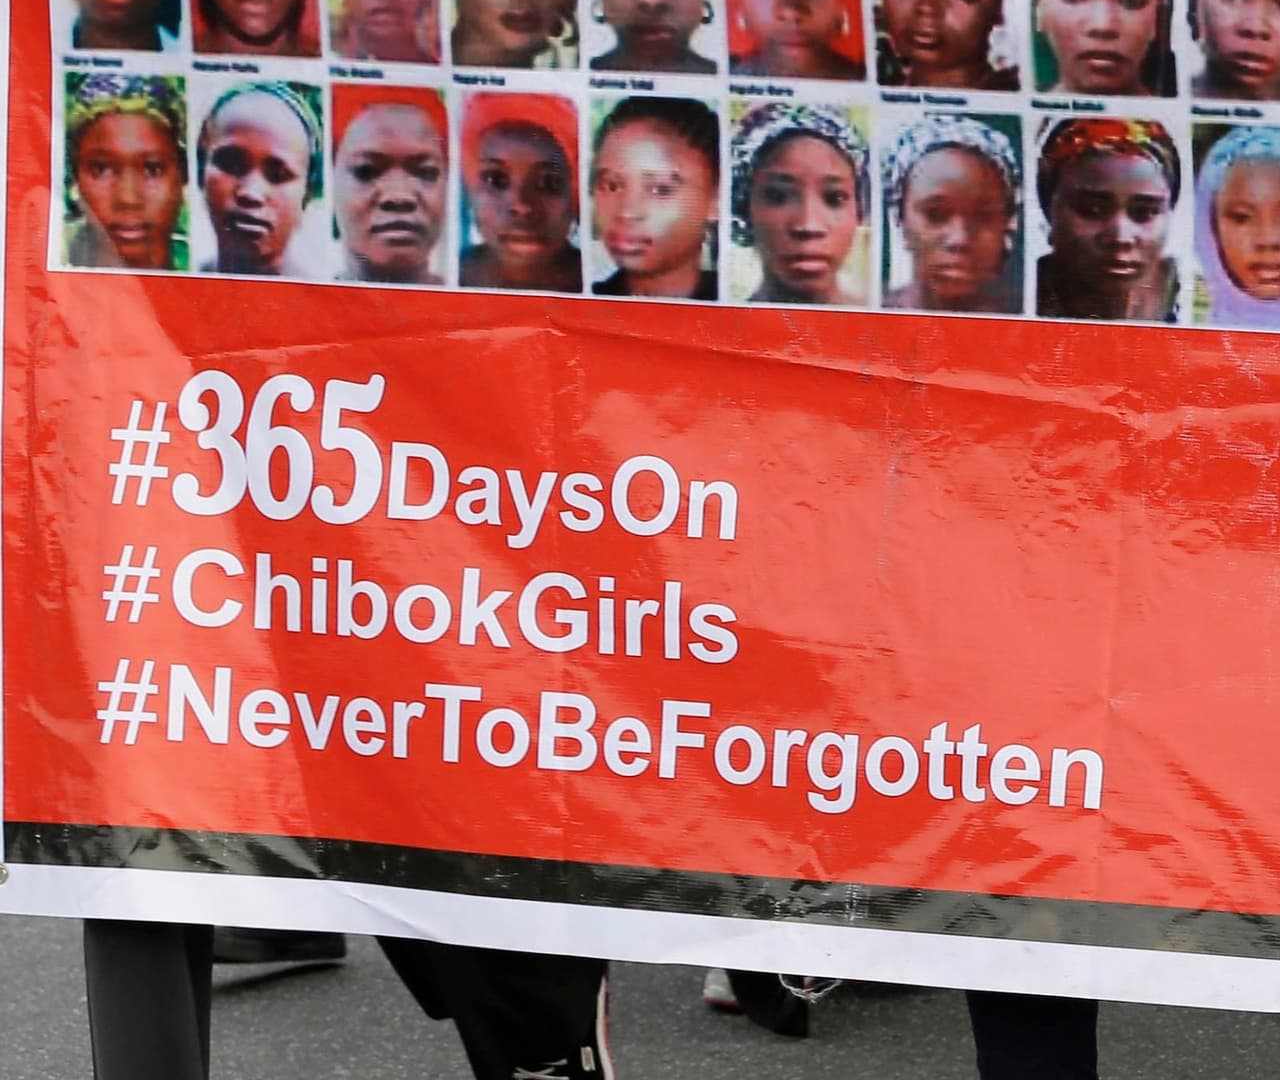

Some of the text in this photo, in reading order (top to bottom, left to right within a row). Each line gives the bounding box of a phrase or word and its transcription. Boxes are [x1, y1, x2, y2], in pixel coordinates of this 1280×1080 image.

[109, 369, 738, 548] #365DaysOn
[101, 544, 739, 664] #ChibokGirls
[95, 658, 1106, 816] #NeverToBeForgotten
